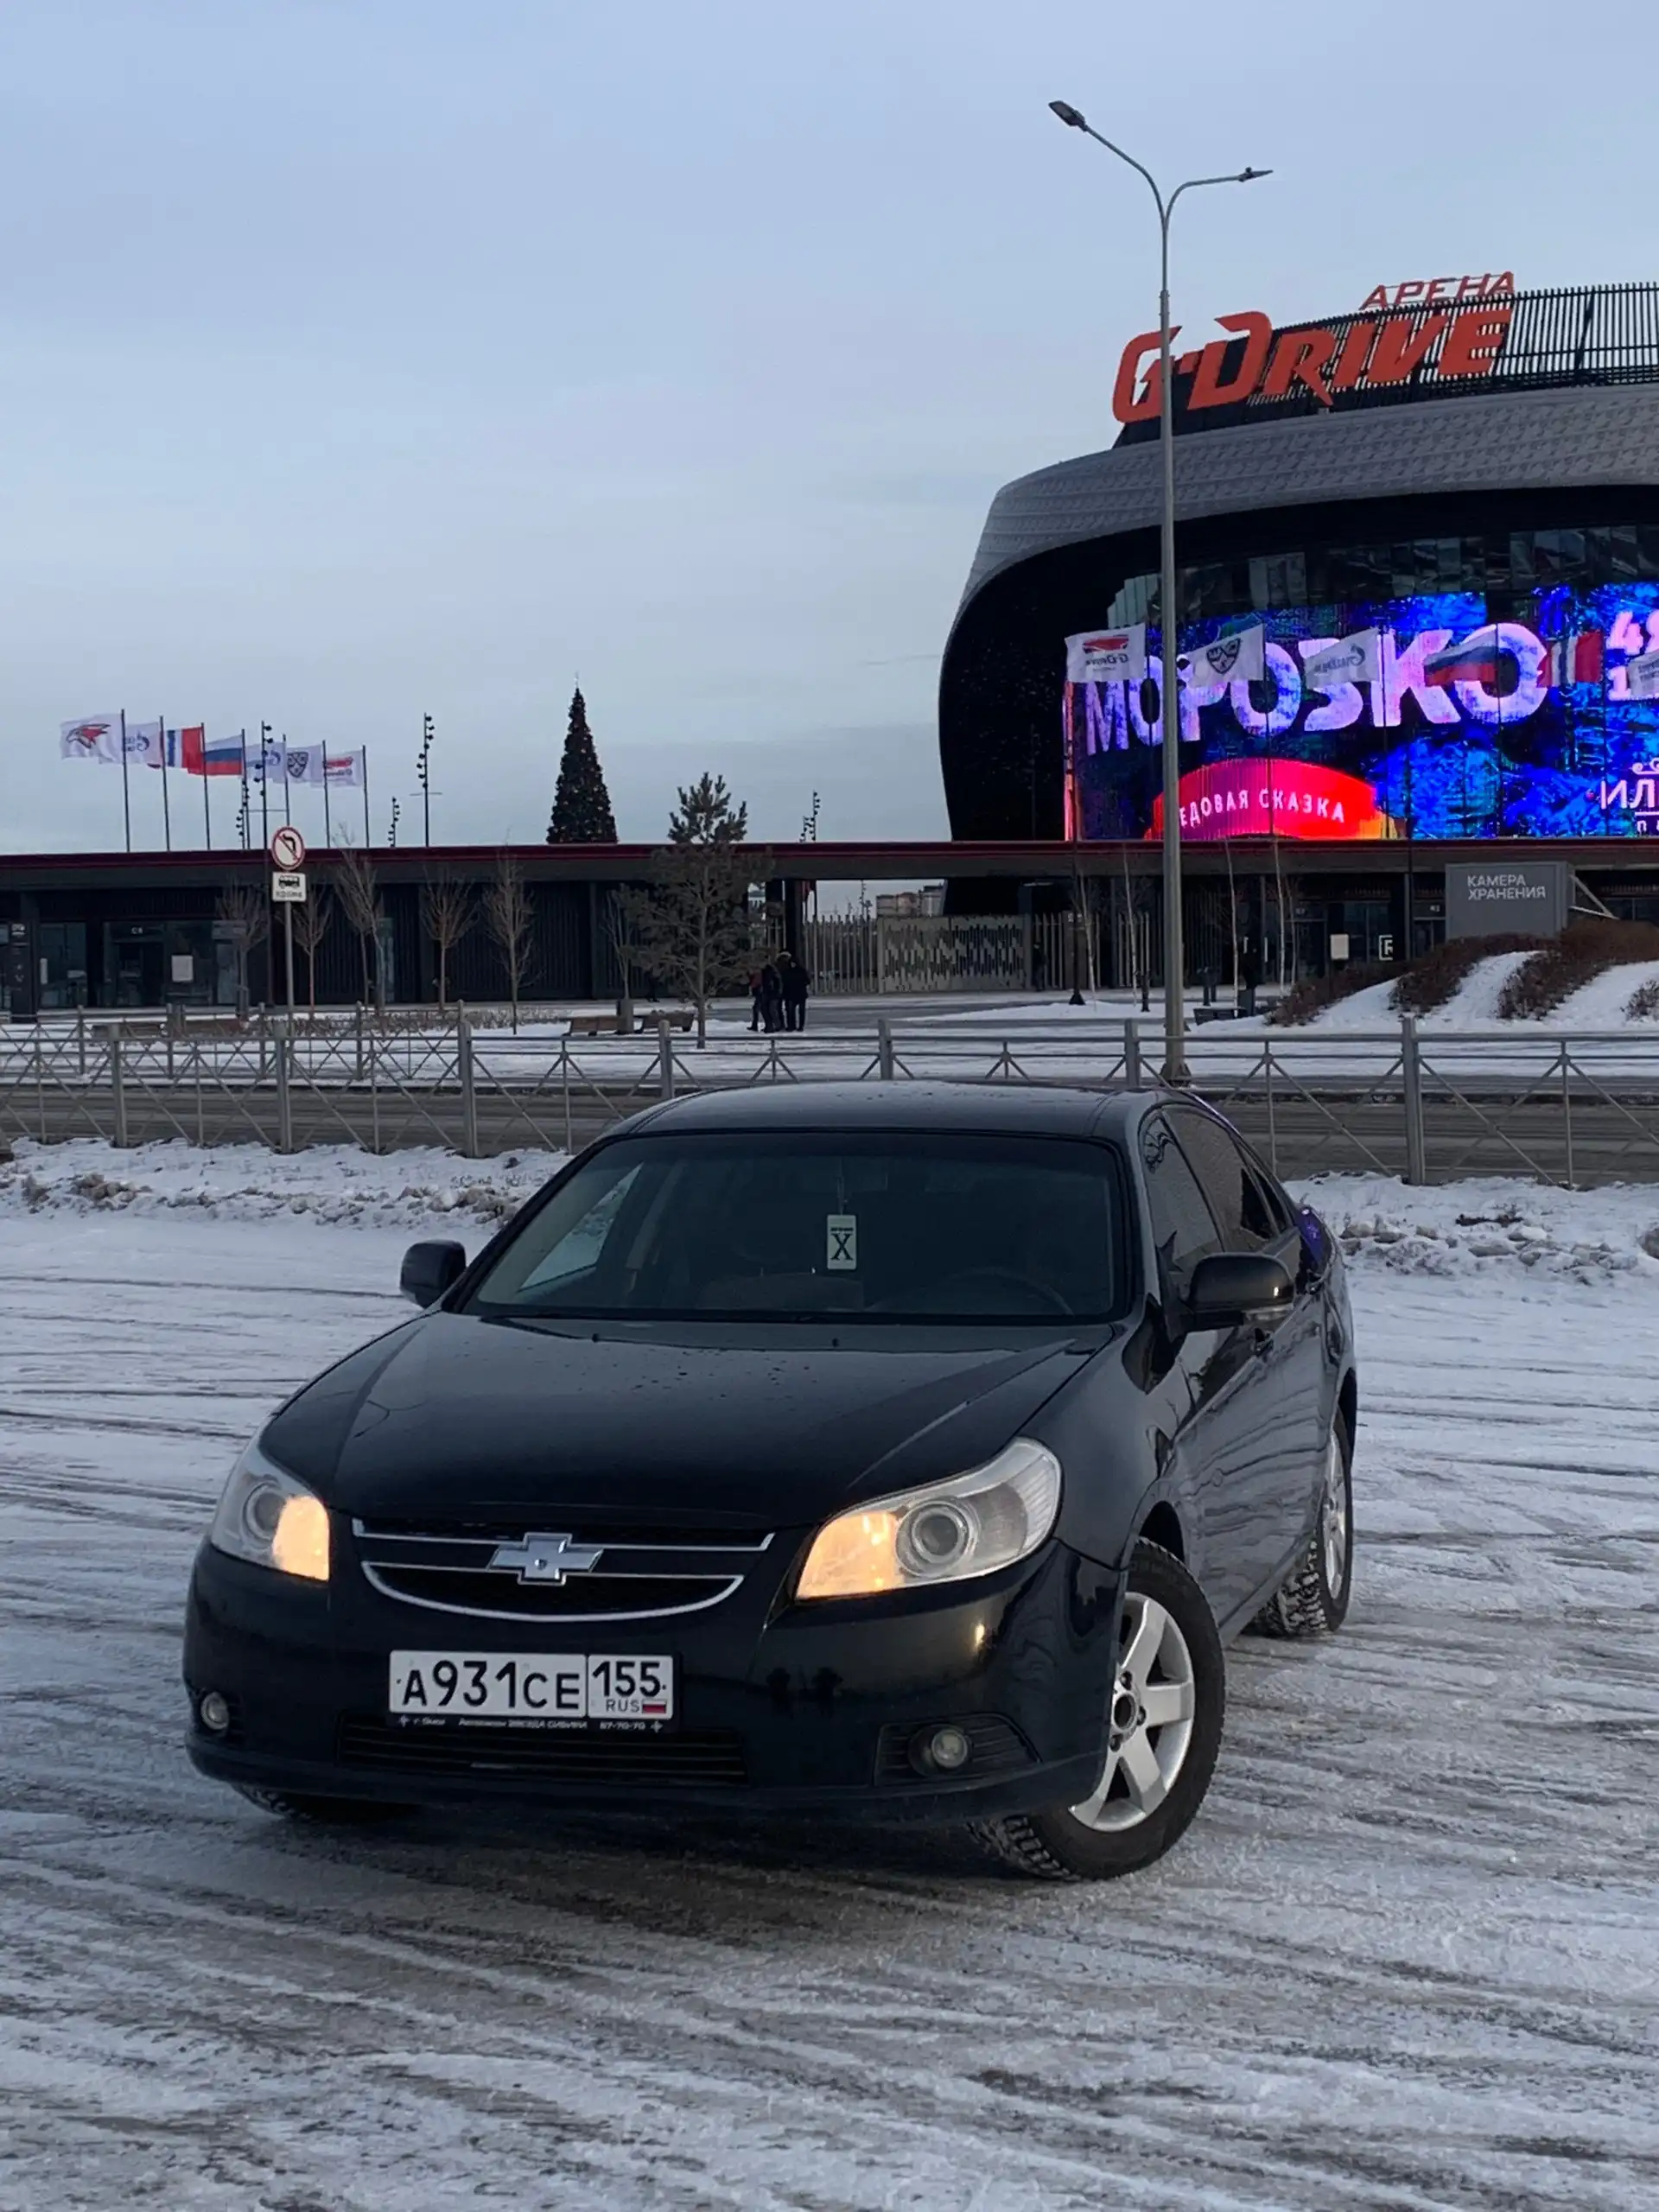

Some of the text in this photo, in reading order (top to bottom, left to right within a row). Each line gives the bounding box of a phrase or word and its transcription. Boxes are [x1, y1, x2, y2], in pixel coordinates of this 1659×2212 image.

[1358, 270, 1514, 310] АРЕНА
[1177, 788, 1344, 827] ЕДОВАЯ СКАЗКА
[1467, 874, 1526, 887] КАМЕРА
[1468, 886, 1546, 900] ХРАНЕНИЯ
[592, 1661, 661, 1698] 155
[606, 1699, 640, 1713] RUS
